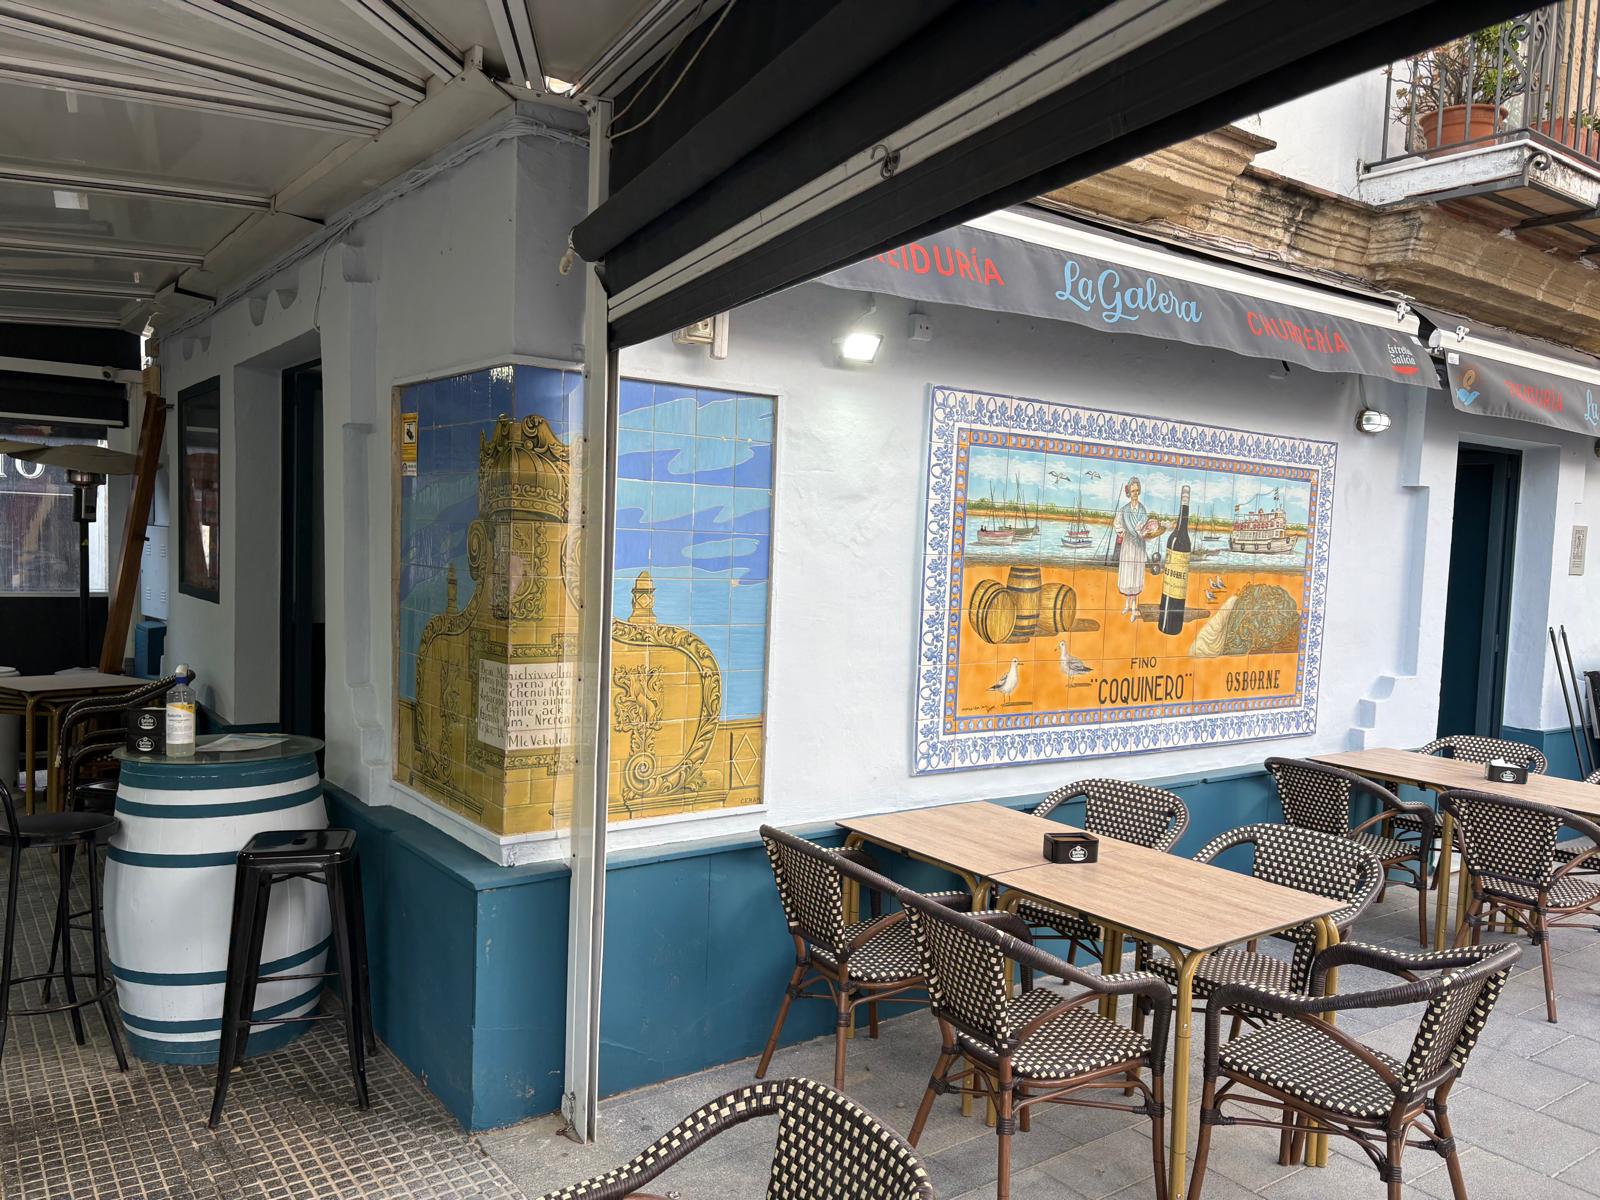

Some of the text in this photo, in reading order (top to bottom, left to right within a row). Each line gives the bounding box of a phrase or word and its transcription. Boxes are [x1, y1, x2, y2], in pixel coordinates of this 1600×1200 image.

[878, 242, 1005, 286] EIDURÍA
[1097, 269, 1202, 323] Galera
[1130, 656, 1157, 670] FINO
[1225, 669, 1281, 692] OSBORNE
